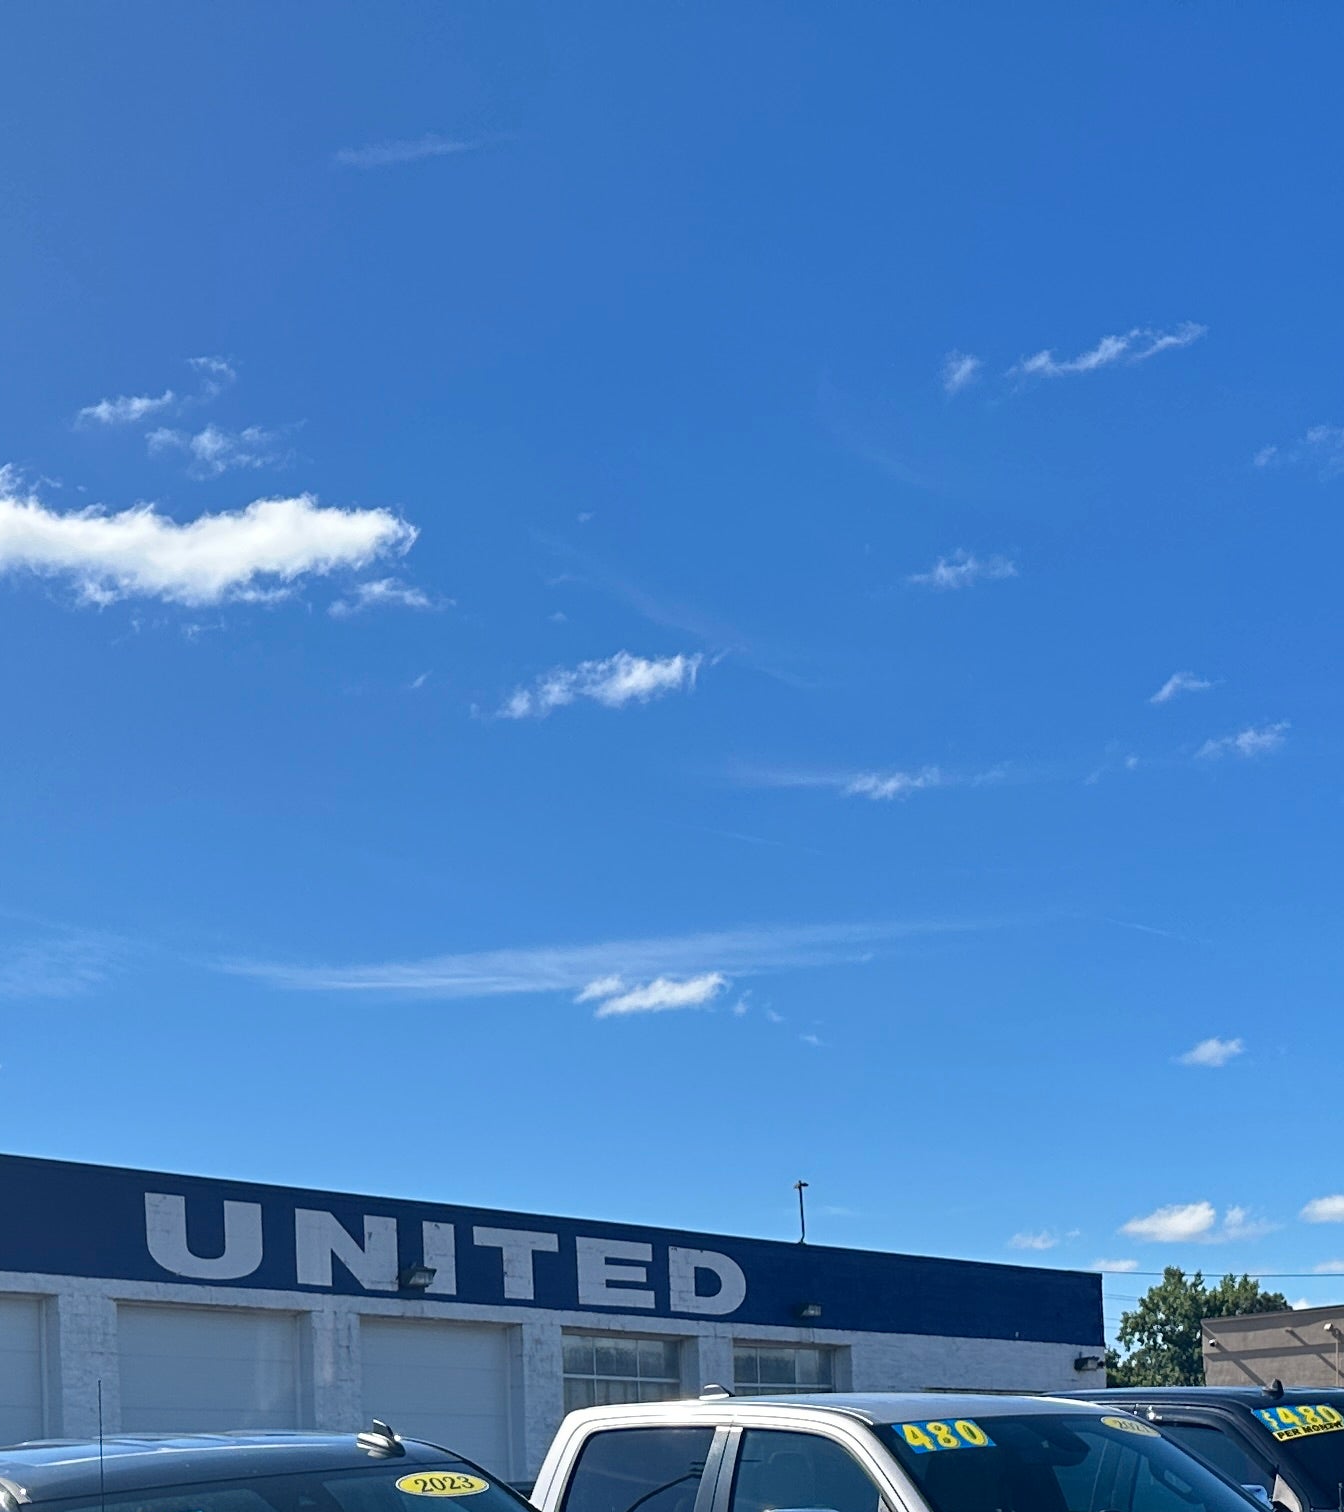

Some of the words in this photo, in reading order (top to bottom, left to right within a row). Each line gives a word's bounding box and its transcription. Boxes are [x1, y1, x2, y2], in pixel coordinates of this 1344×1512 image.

[144, 1192, 747, 1316] UNITED
[1260, 1404, 1344, 1431] $480
[902, 1419, 989, 1452] 480
[1276, 1428, 1302, 1440] PER
[413, 1473, 474, 1494] 2023
